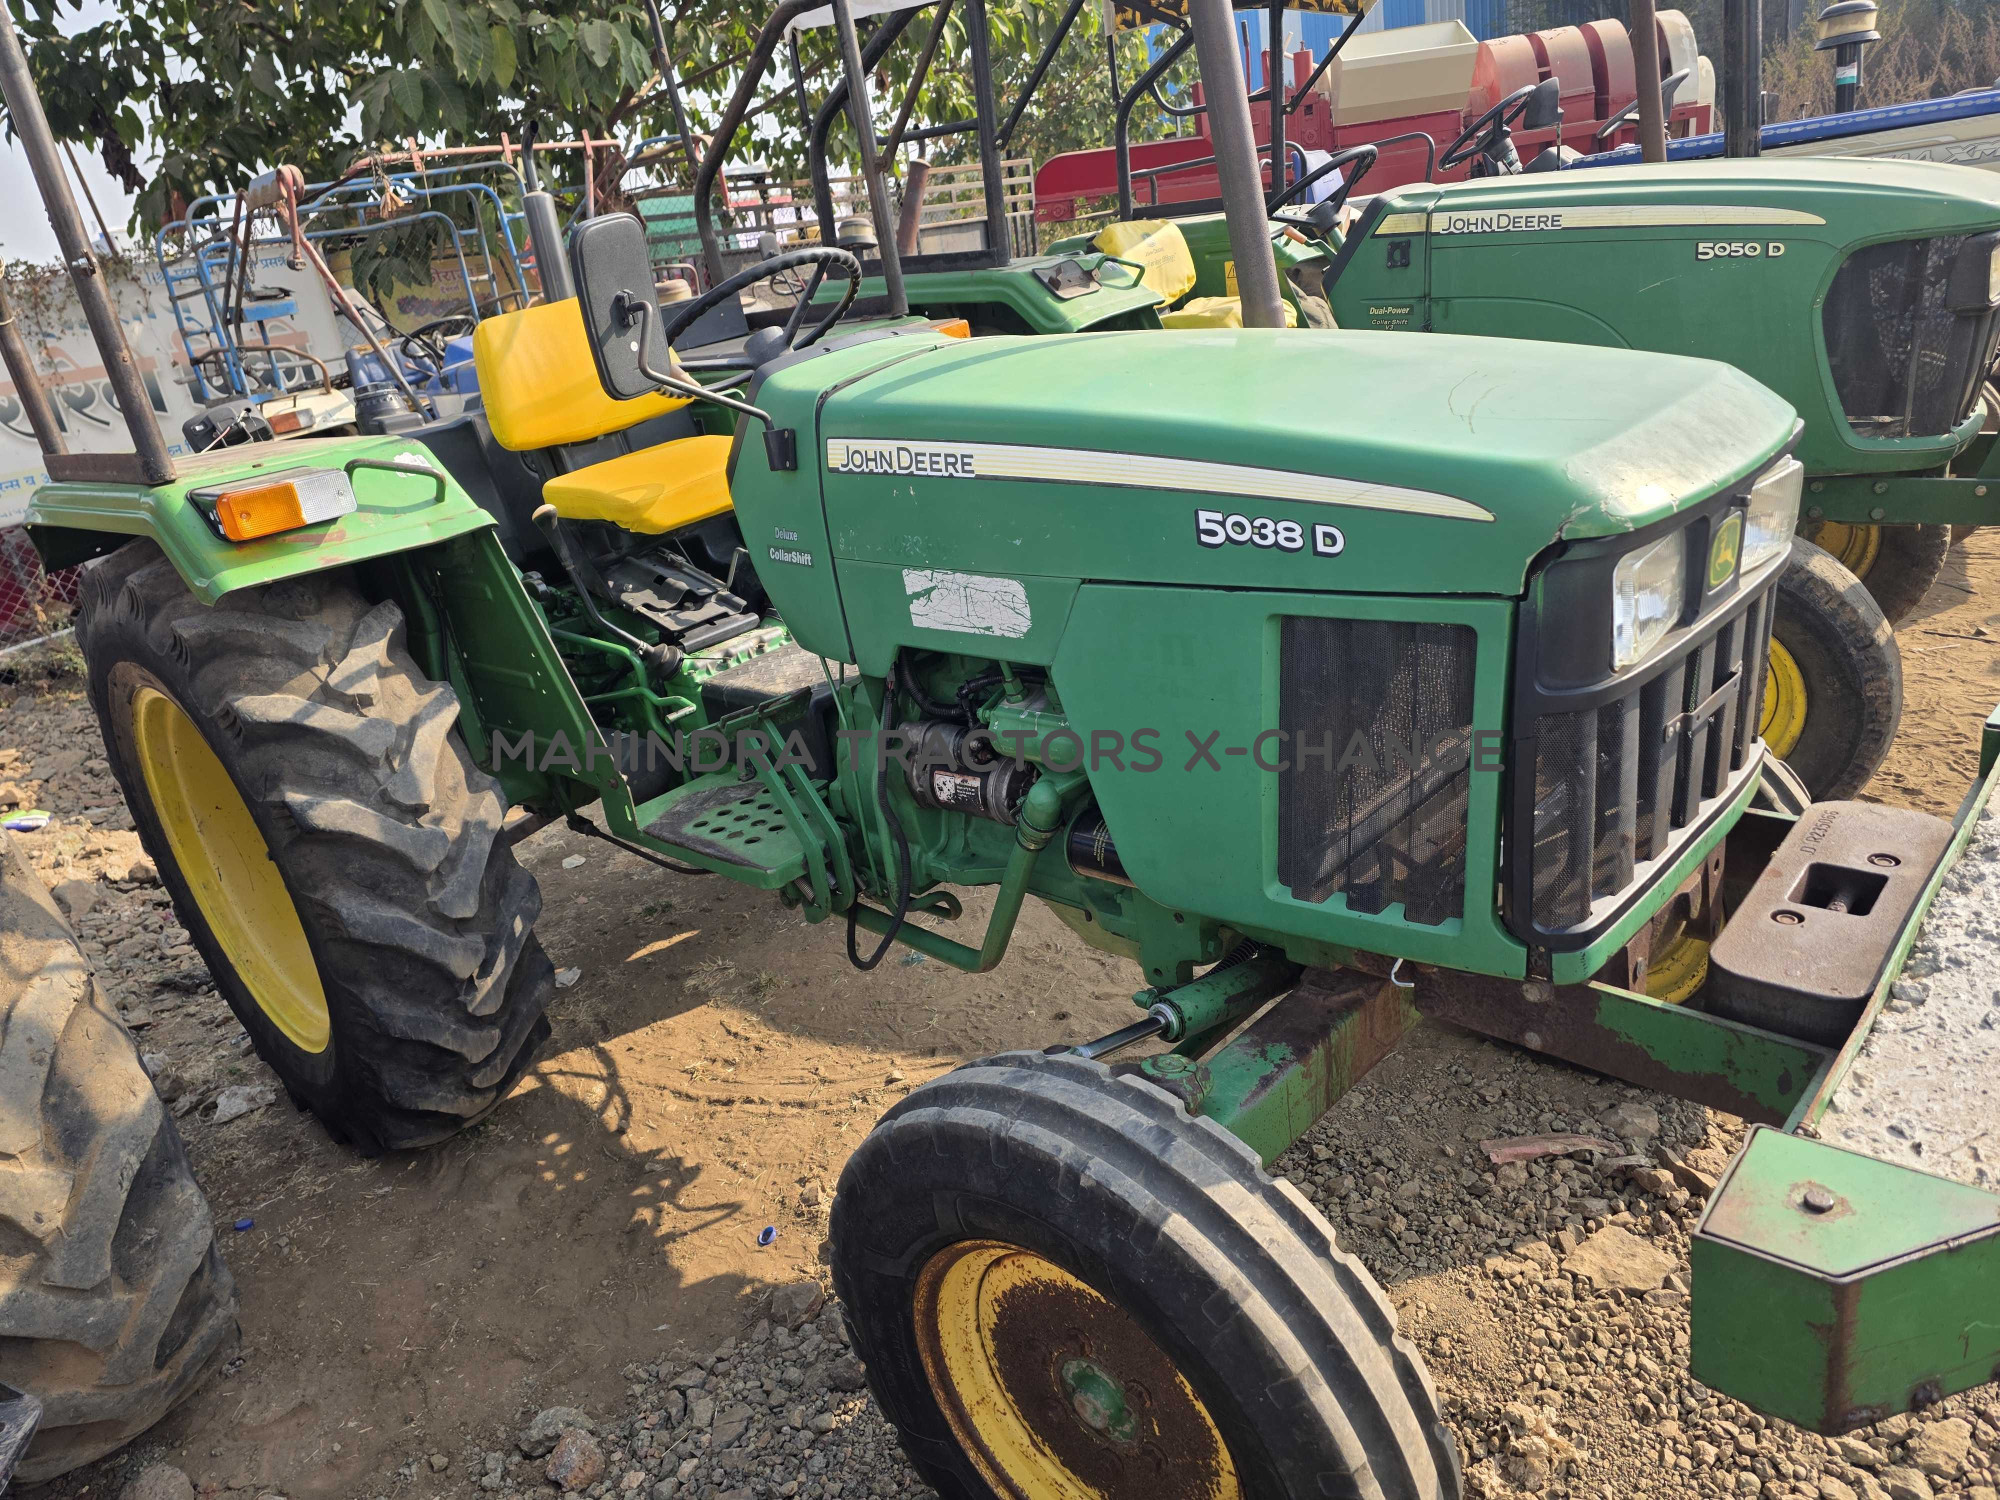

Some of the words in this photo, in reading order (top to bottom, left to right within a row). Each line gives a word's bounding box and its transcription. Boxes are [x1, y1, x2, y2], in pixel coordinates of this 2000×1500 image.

[1441, 215, 1493, 233] JOHN
[1496, 213, 1563, 231] DEERE
[1696, 241, 1761, 260] 5050
[1766, 241, 1785, 258] D
[1369, 306, 1411, 315] Dual-Power
[840, 445, 894, 471] JOHN
[896, 446, 975, 475] DEERE
[774, 526, 798, 541] Deluxe
[1195, 508, 1305, 553] 5038
[1311, 522, 1346, 558] D
[769, 547, 812, 566] CollarShift
